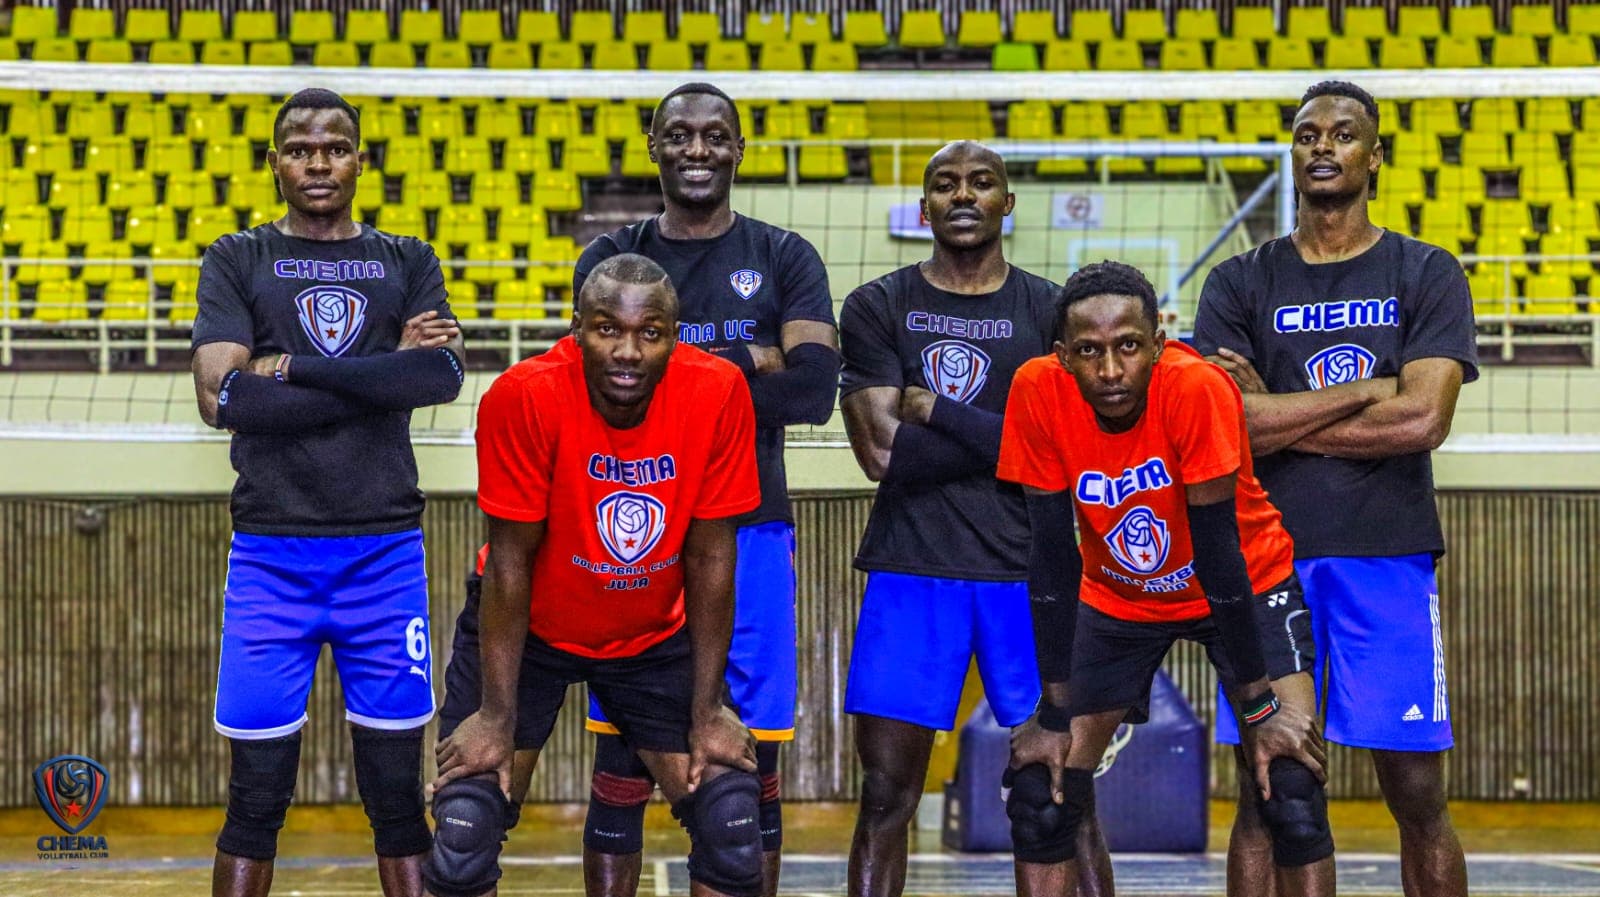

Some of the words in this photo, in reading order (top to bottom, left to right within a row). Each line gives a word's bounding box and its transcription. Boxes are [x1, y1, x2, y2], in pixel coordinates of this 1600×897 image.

[274, 258, 385, 281] CHEMA
[906, 311, 1013, 339] CHEMA
[1274, 296, 1399, 333] CHEMA
[587, 452, 676, 487] CHEMA
[604, 577, 650, 590] JUJA
[405, 616, 427, 661] 6
